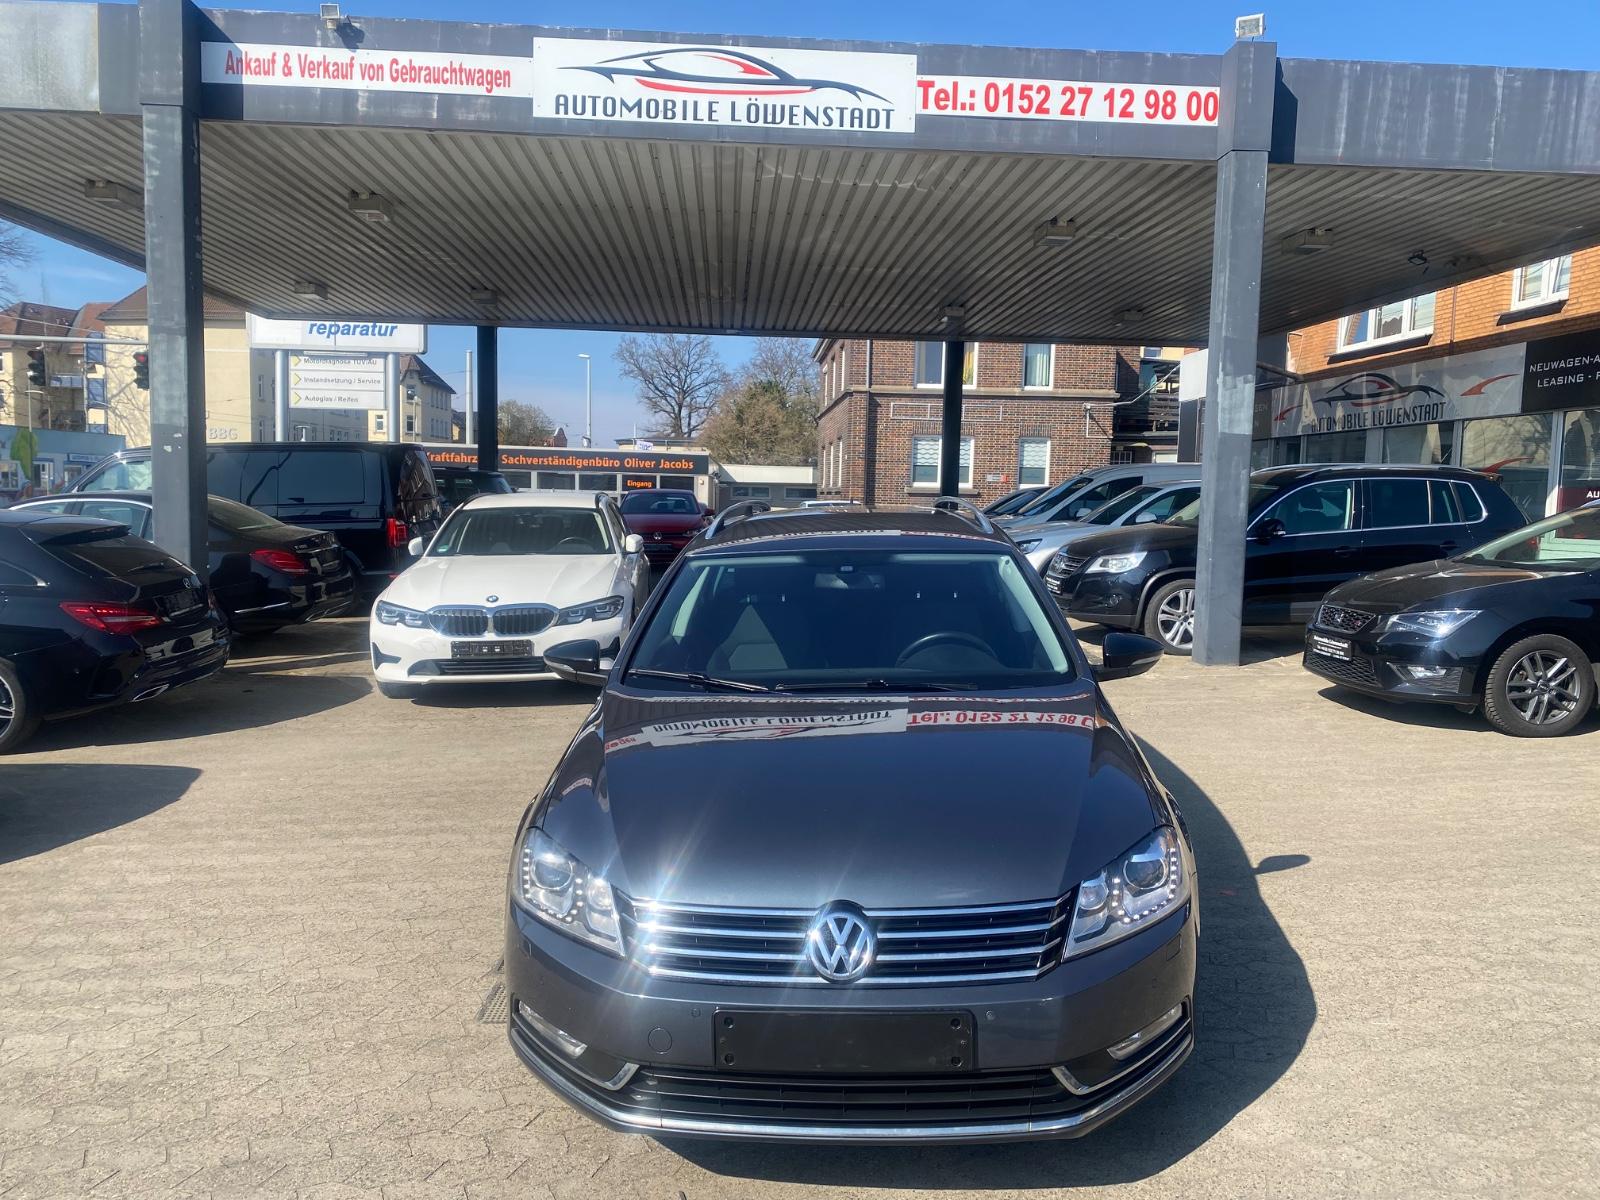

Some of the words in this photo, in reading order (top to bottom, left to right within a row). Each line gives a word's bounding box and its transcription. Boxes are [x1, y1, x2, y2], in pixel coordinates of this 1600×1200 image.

[224, 50, 276, 77] Ankauf
[281, 54, 292, 77] &
[297, 53, 355, 80] Verkauf
[359, 61, 384, 82] von
[389, 57, 511, 93] Gebrauchtwagen
[916, 79, 976, 111] Tel.:
[984, 82, 1050, 114] 0152
[1060, 85, 1093, 117] 27
[1103, 87, 1135, 118] 12
[1144, 89, 1176, 120] 98
[1186, 91, 1218, 121] 00
[554, 94, 719, 122] AUTOMOBILE
[730, 97, 895, 130] LÖWENSTADT
[308, 320, 398, 339] reparatur
[1537, 373, 1584, 388] LEASING
[1372, 401, 1447, 427] LÖWENSTADT
[501, 454, 620, 468] Sachverständigenbüro
[624, 457, 656, 468] Oliver
[659, 458, 694, 469] Jacobs
[627, 480, 653, 488] Eingang
